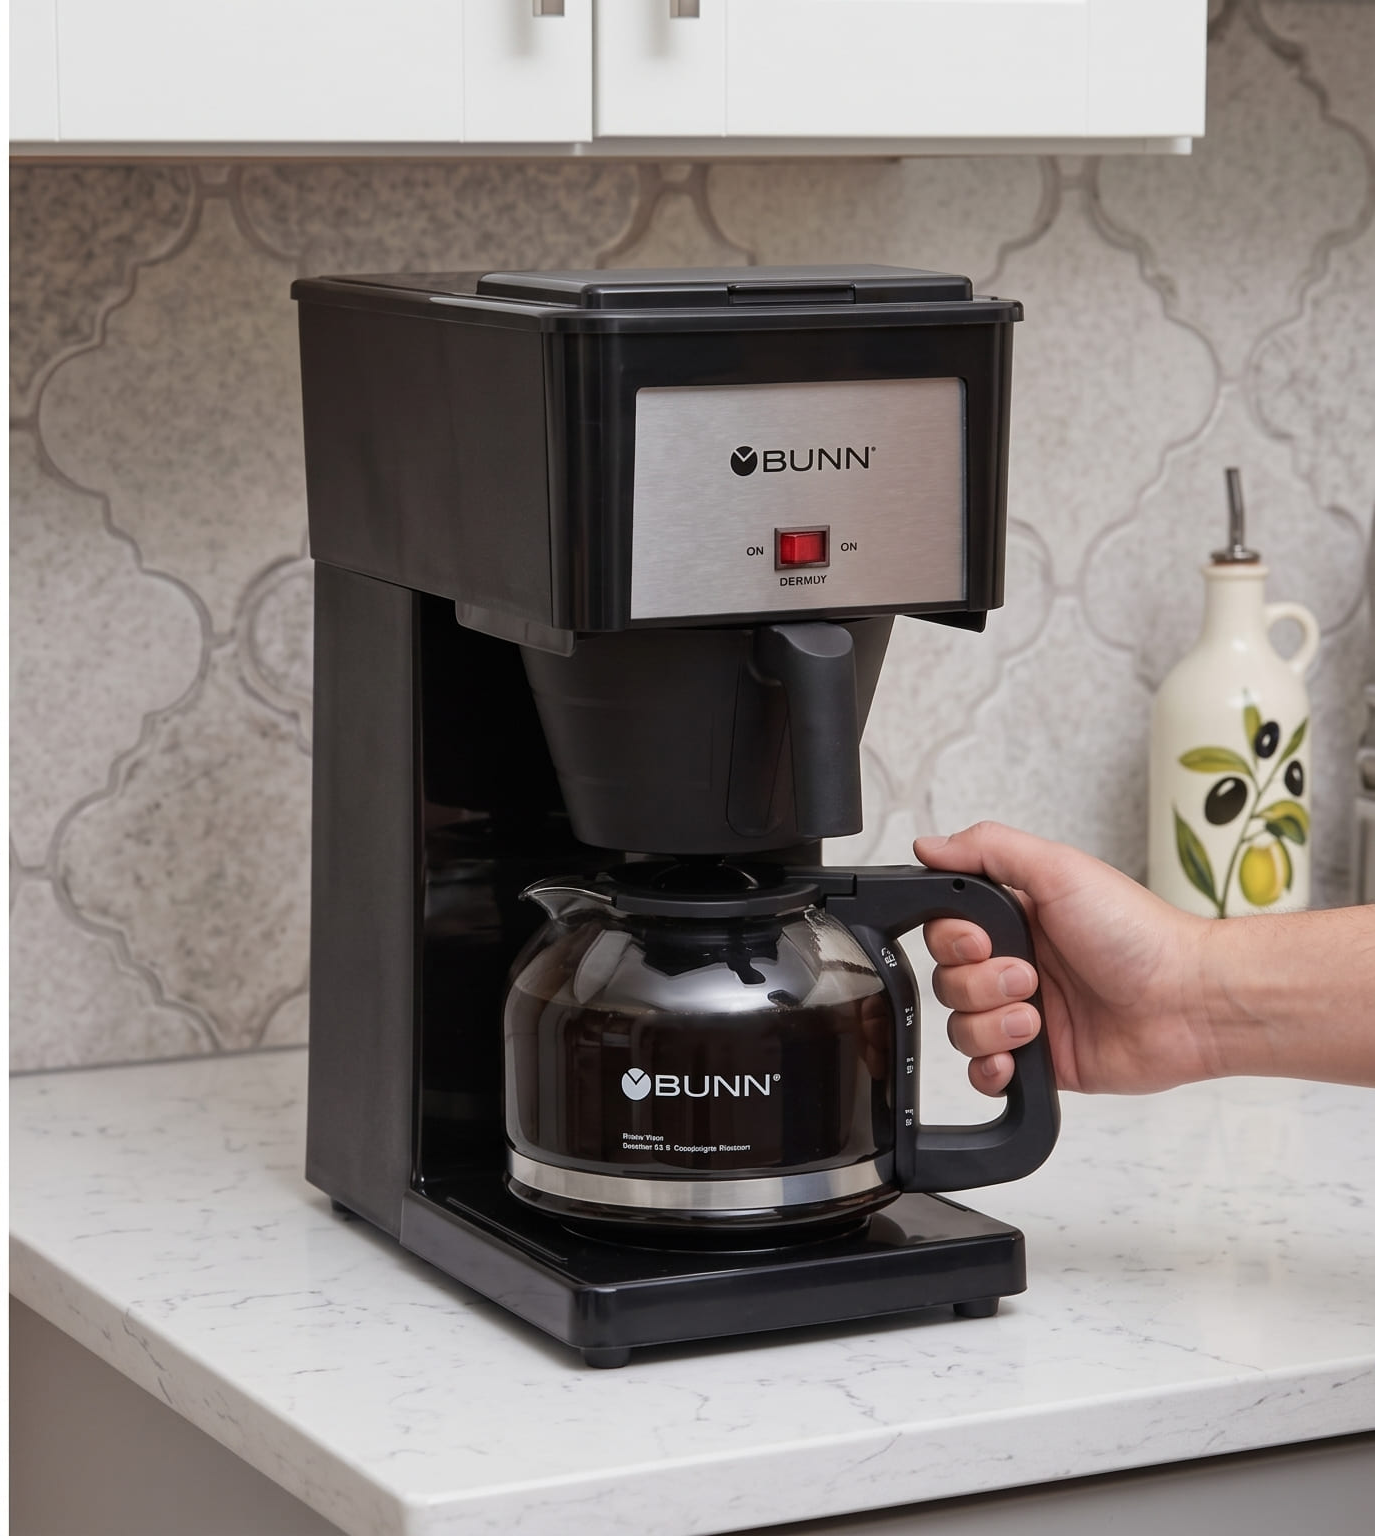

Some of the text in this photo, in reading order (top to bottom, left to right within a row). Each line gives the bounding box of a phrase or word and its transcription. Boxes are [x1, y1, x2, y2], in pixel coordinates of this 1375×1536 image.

[746, 546, 765, 557] ON
[840, 542, 858, 552] ON
[779, 574, 828, 587] DERMUY
